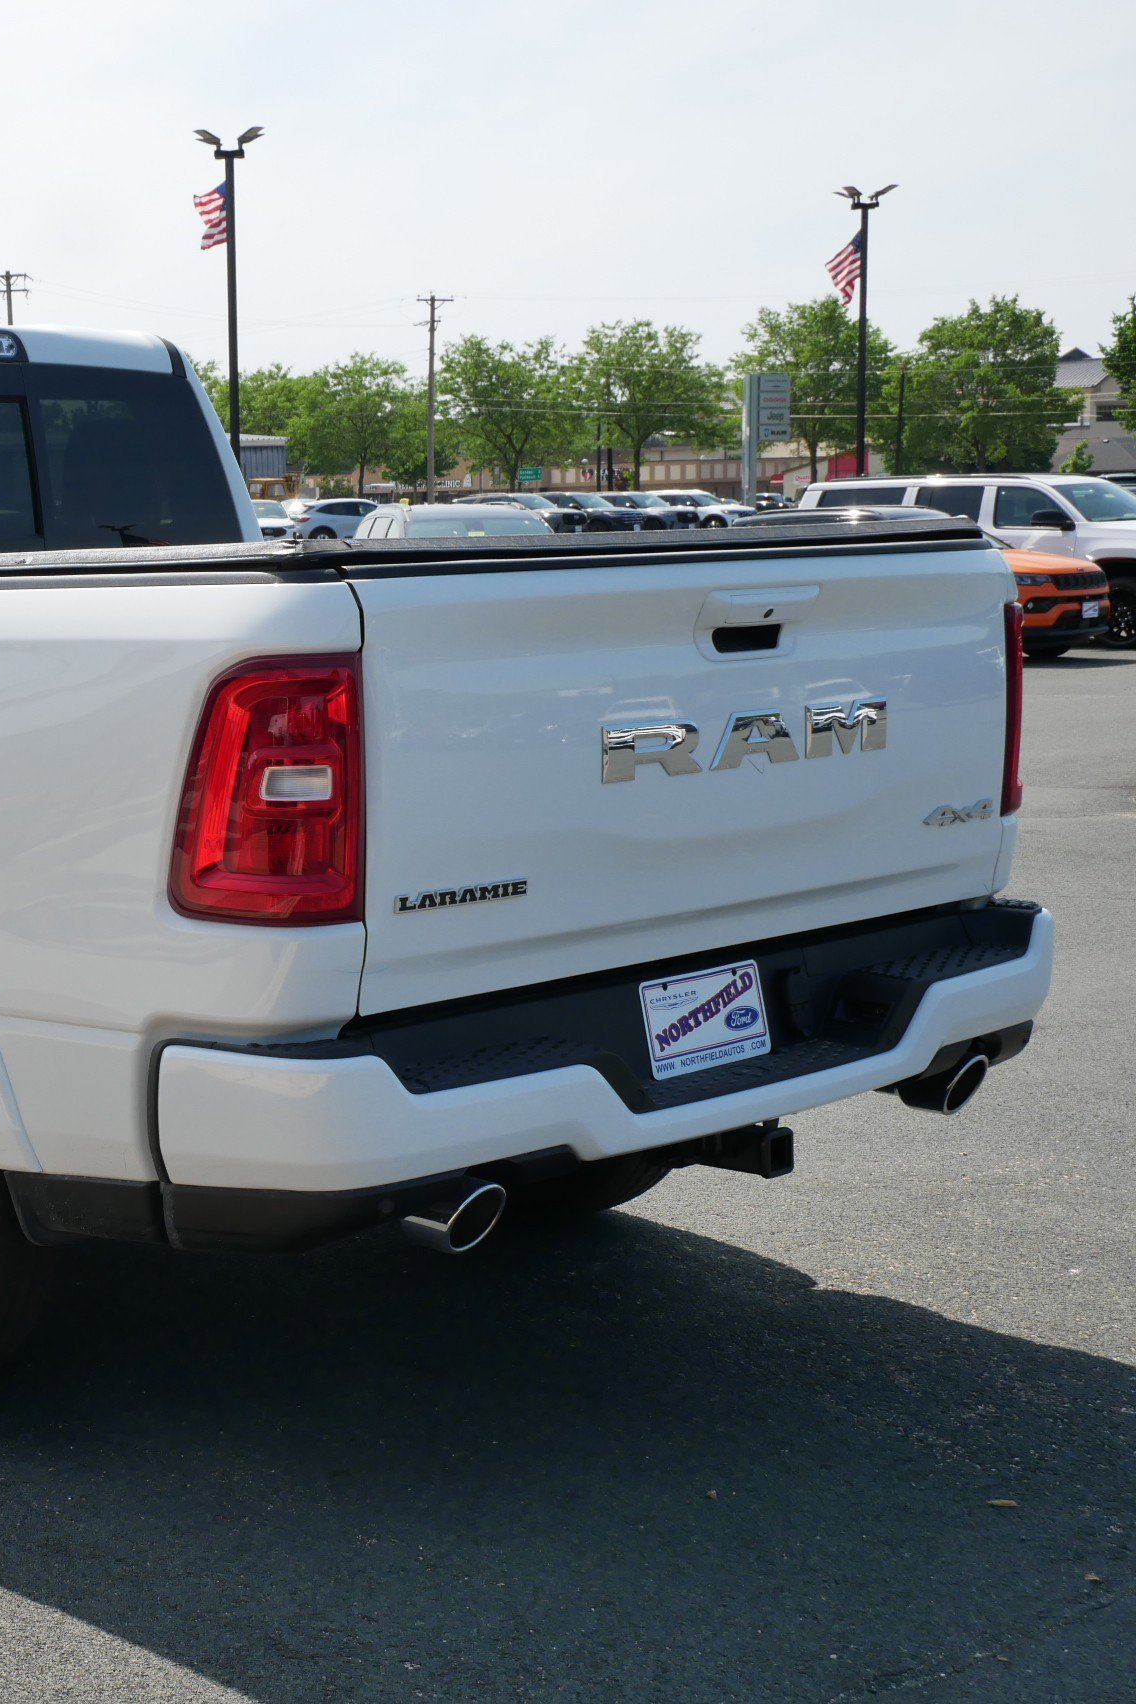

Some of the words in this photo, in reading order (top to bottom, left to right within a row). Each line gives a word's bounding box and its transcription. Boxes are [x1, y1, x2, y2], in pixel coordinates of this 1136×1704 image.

[767, 411, 784, 421] Jeep
[601, 696, 887, 784] RAM
[397, 879, 528, 912] LARAMIE
[649, 990, 697, 1005] CHRYSLER
[654, 971, 754, 1053] NORTHFIELD
[730, 1010, 752, 1027] Ford
